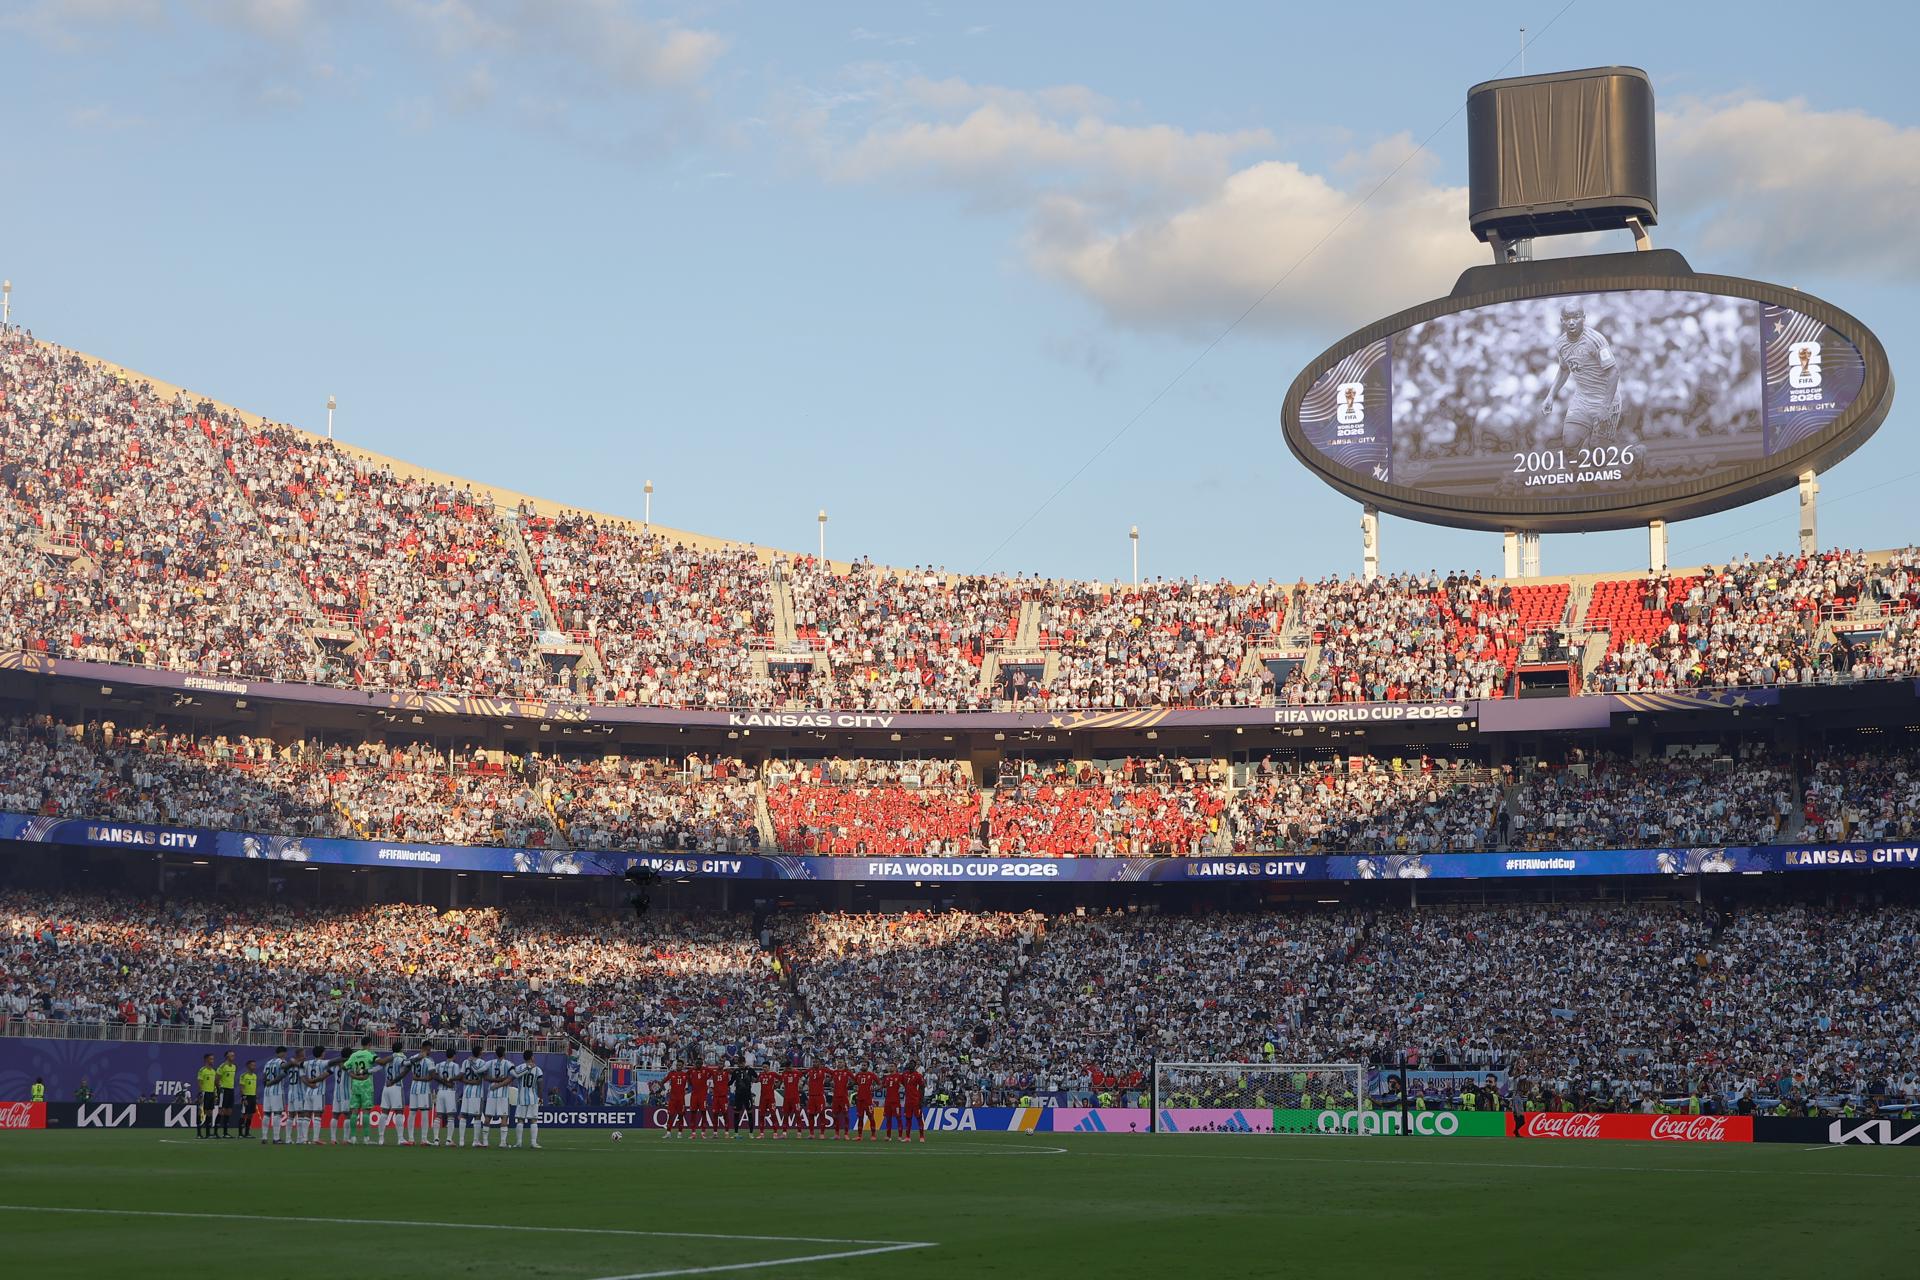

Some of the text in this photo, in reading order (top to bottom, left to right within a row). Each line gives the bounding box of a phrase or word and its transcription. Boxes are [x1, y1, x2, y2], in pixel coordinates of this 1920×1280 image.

[1789, 393, 1823, 403] 2026
[1815, 402, 1836, 410] CITY
[1513, 444, 1634, 473] 2001-2026
[1525, 469, 1622, 486] JAYDEN ADAMS
[184, 677, 248, 695] #FIFAWorldCup
[729, 714, 894, 728] KANSAS CITY
[1274, 705, 1463, 723] FIFA WORLD CUP 2026
[88, 826, 198, 848] KANSAS CITY
[379, 848, 441, 864] #FIFAWorldCup
[1786, 847, 1919, 865] KANSAS CITY
[702, 859, 742, 873] CITY
[869, 863, 1058, 876] FIFA WORLD CUP 2026
[1187, 861, 1307, 876] KANSAS CITY
[1506, 858, 1576, 871] #FIFAWorldCup
[155, 1080, 183, 1096] FIFA
[523, 1073, 534, 1088] 10
[1031, 1096, 1059, 1108] IFA
[77, 1103, 137, 1127] KIA
[515, 1111, 636, 1125] EDICTSTREET
[920, 1108, 977, 1131] VISA
[1317, 1110, 1459, 1135] aramco
[1528, 1112, 1606, 1138] Coca-Cola
[1650, 1114, 1729, 1141] Coca-Cola
